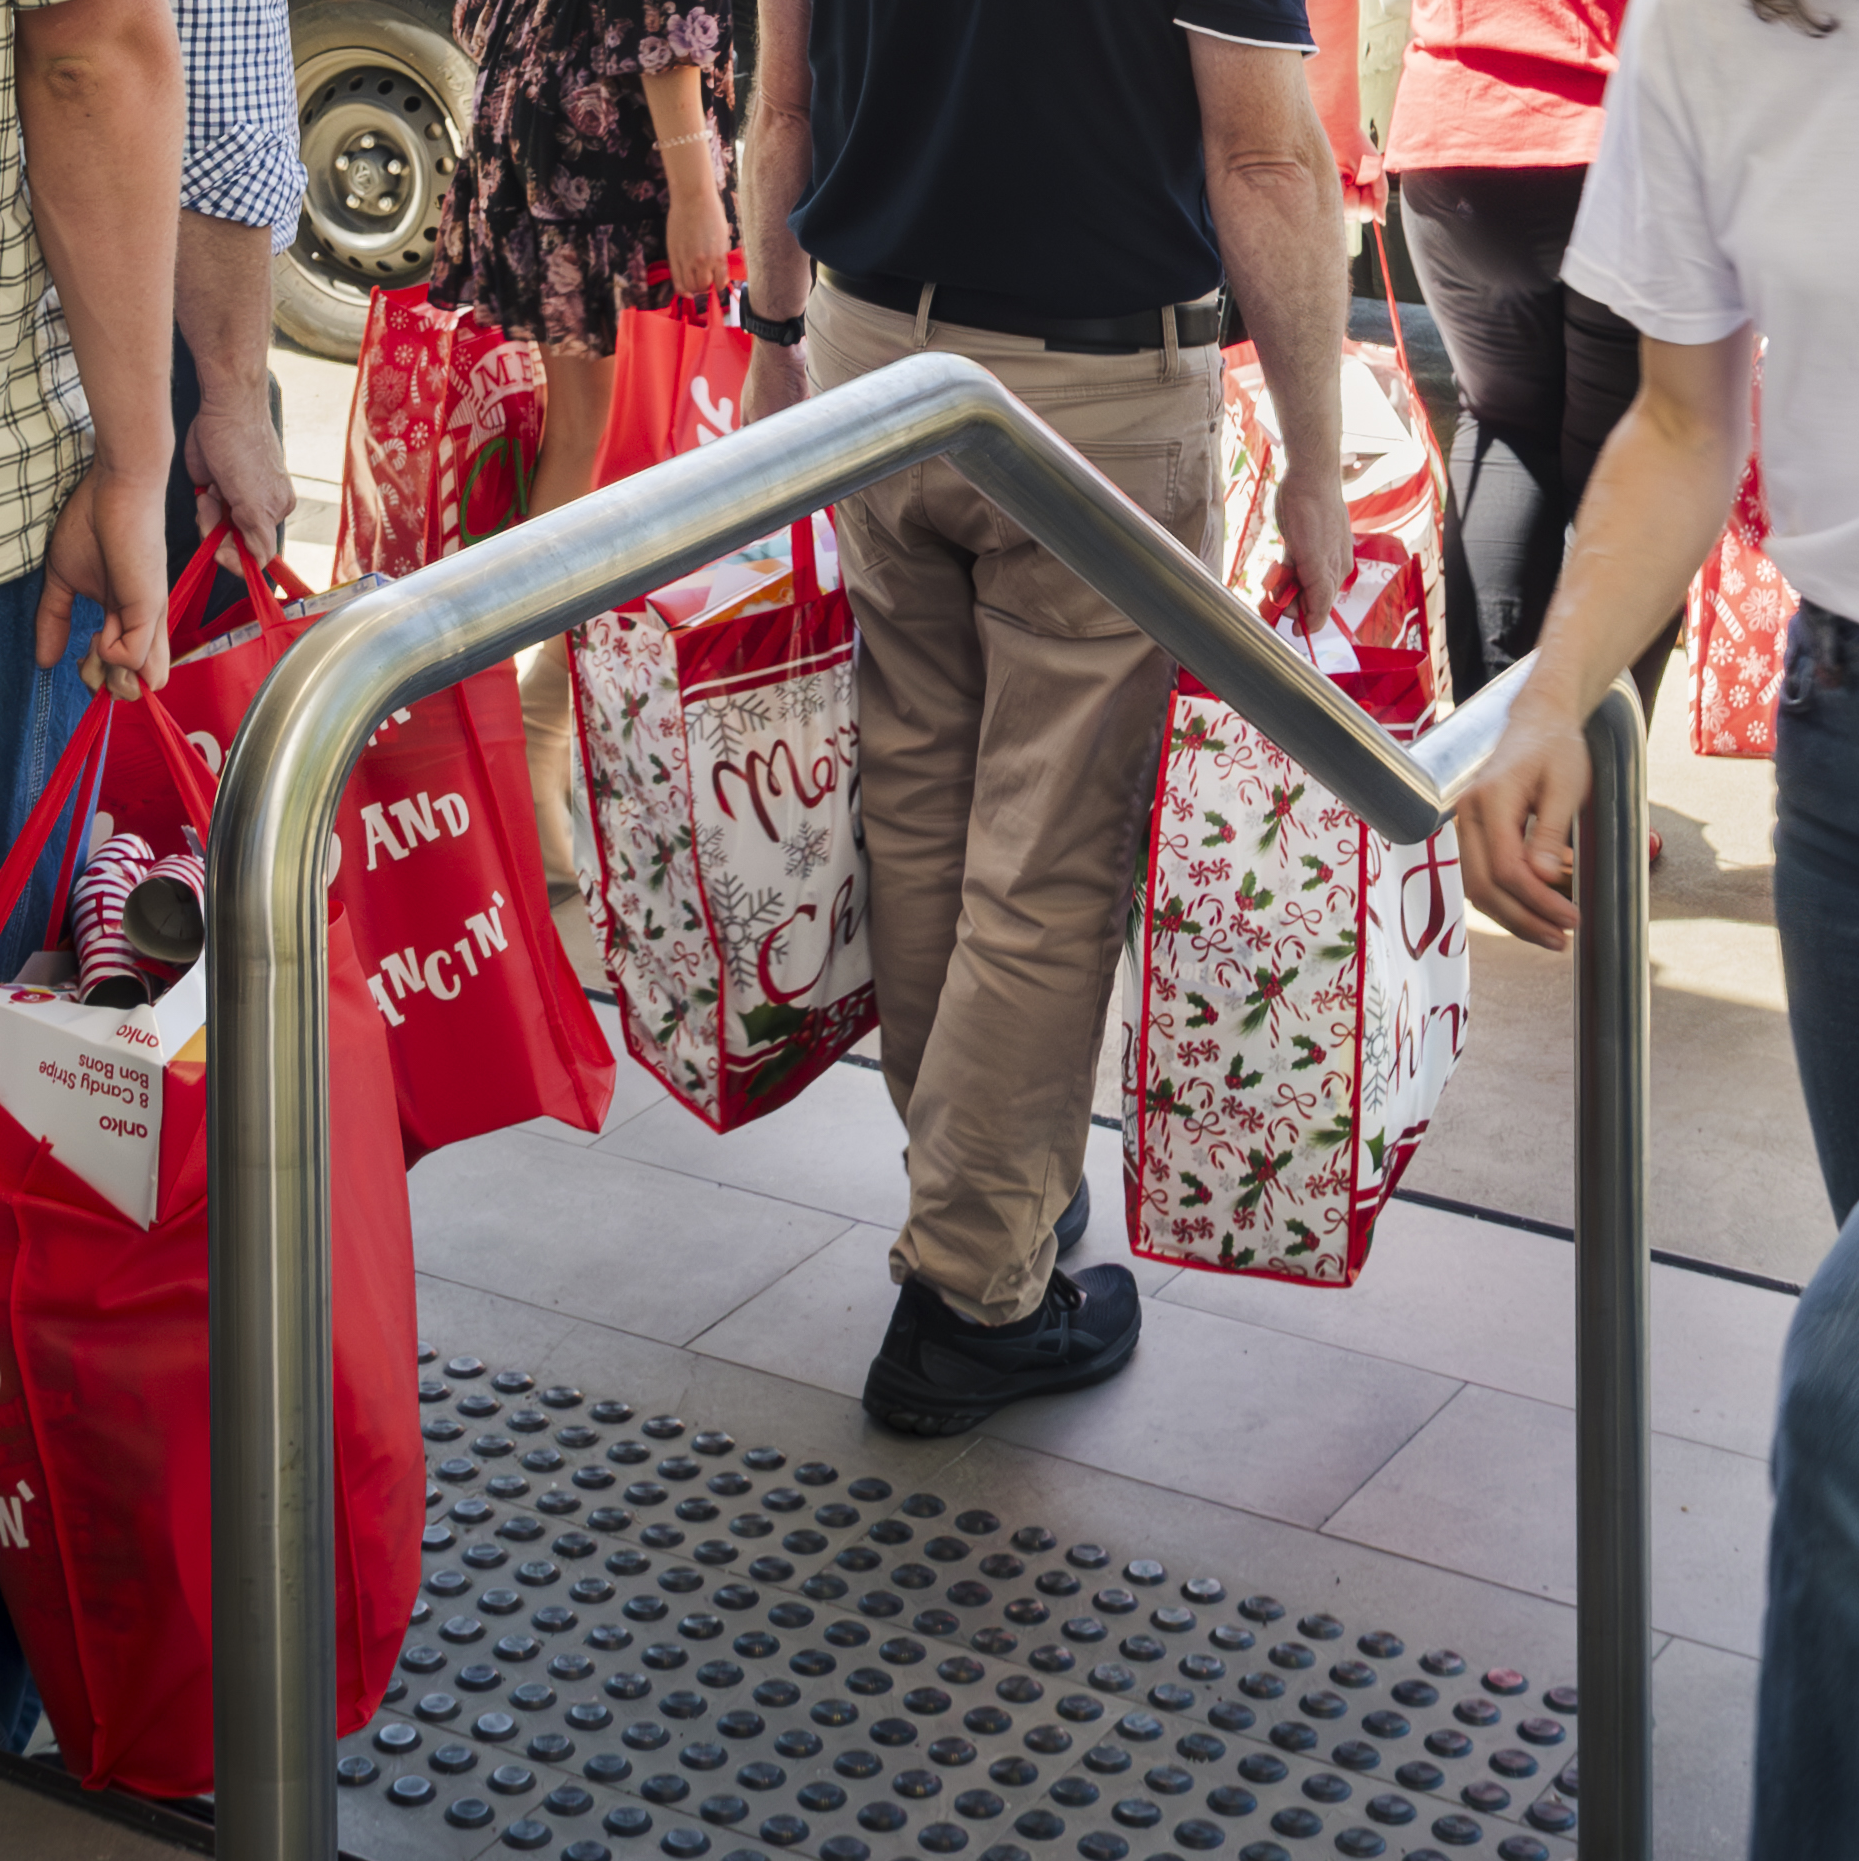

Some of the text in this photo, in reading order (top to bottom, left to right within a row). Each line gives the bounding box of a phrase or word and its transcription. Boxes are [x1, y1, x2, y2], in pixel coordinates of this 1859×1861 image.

[360, 791, 470, 872] AND
[367, 890, 505, 1027] ANCIN'
[116, 1024, 160, 1048] anko
[38, 1060, 150, 1109] 8 Candy Stripe
[78, 1054, 150, 1090] Bon Bons
[99, 1115, 149, 1139] anko
